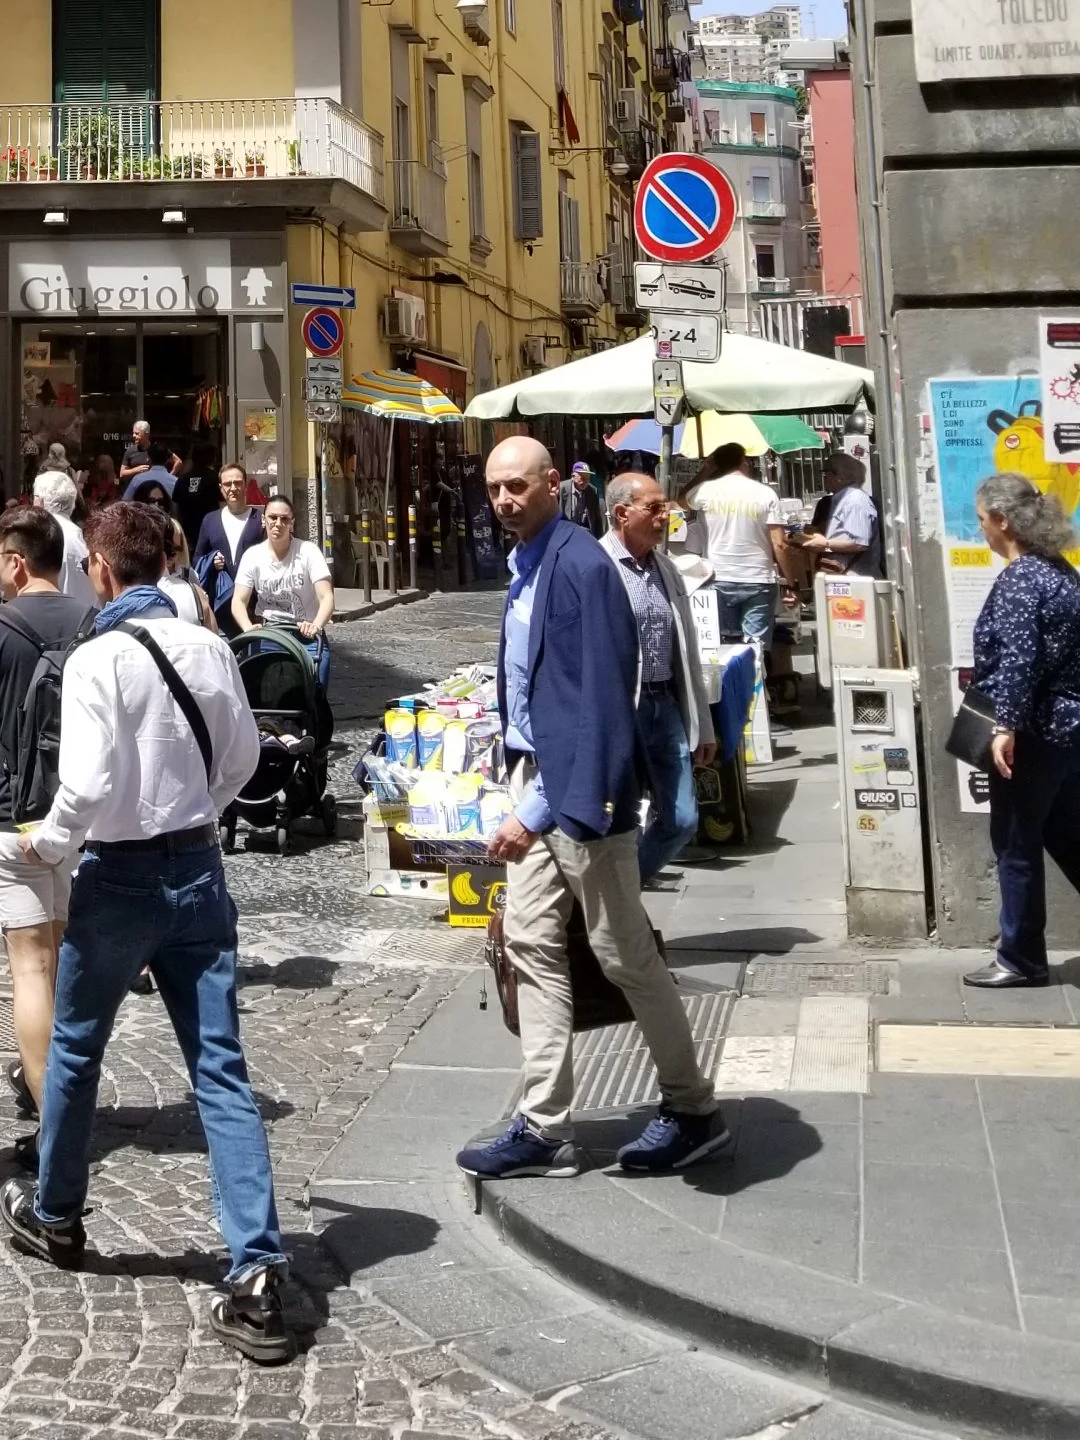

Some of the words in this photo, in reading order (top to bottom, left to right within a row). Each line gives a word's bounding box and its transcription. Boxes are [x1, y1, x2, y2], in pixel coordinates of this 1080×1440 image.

[934, 46, 972, 63] LIMITE
[20, 274, 219, 311] Giuggiolo
[942, 400, 951, 409] LA
[953, 399, 987, 409] BELLEZZA
[949, 410, 958, 418] CI
[944, 420, 964, 428] SONO
[945, 429, 958, 438] GLI
[859, 792, 896, 804] GIUSO
[859, 817, 875, 831] 55
[462, 917, 490, 925] PREMIU
